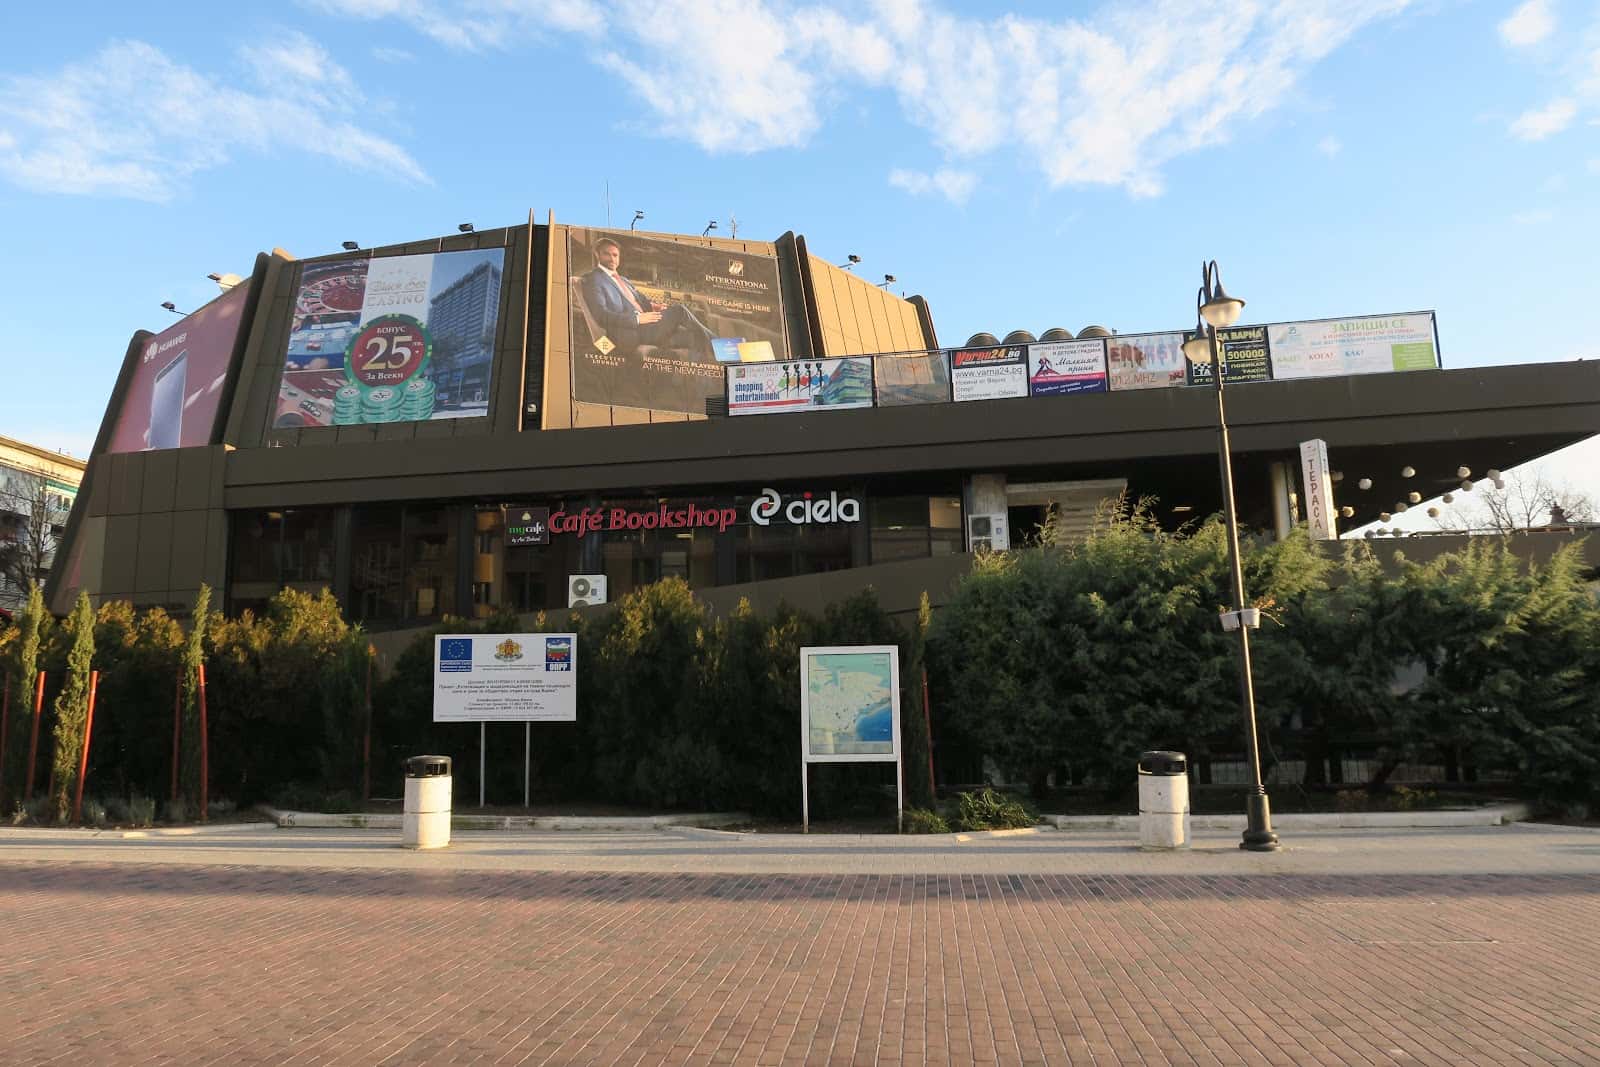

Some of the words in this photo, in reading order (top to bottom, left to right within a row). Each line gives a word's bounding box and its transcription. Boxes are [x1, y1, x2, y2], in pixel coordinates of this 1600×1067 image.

[705, 275, 769, 290] INTERNATIONAL
[367, 294, 426, 307] CASINO
[708, 297, 721, 306] THE
[722, 299, 744, 309] GAME
[752, 304, 771, 313] HERE
[376, 326, 407, 335] БОНУС
[1331, 319, 1388, 333] ЗАПИШИ
[1392, 319, 1408, 329] СЕ
[1230, 329, 1263, 340] ВАРНА
[360, 335, 413, 371] 25
[1309, 351, 1334, 360] КОГА?
[592, 360, 619, 368] LOUNGE
[642, 362, 654, 370] AT
[655, 364, 673, 373] THE
[674, 366, 696, 376] NEW
[643, 356, 671, 366] REWARD
[672, 359, 690, 368] YOUR
[690, 361, 721, 371] PLAYERS
[377, 371, 404, 380] Всеки
[955, 366, 1023, 377] www.varna24.bg
[734, 382, 764, 393] shopping
[734, 391, 781, 403] entertainment
[1308, 459, 1323, 530] ТЕРАСА
[785, 490, 860, 523] ciela
[550, 507, 603, 538] Café
[609, 503, 737, 533] Bookshop
